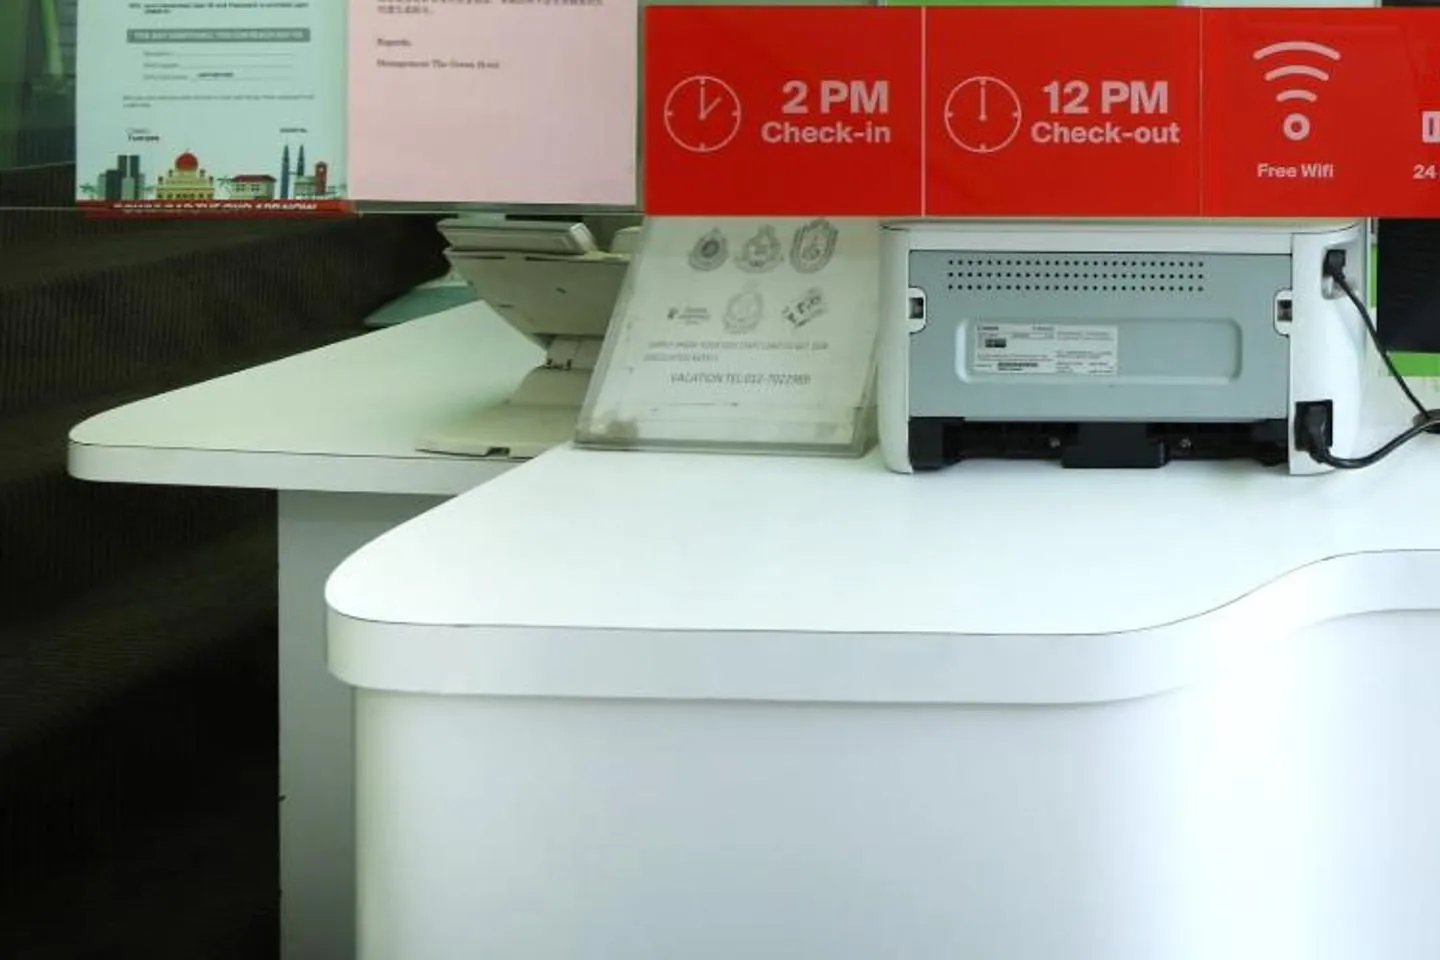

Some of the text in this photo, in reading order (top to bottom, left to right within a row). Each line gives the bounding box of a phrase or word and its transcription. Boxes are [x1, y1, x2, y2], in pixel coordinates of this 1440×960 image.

[782, 81, 889, 113] 2 PM
[1043, 81, 1169, 113] 12 PM
[761, 122, 891, 144] Check-in
[1031, 122, 1180, 144] Check-out
[1257, 163, 1297, 177] Free
[1413, 165, 1436, 179] 24
